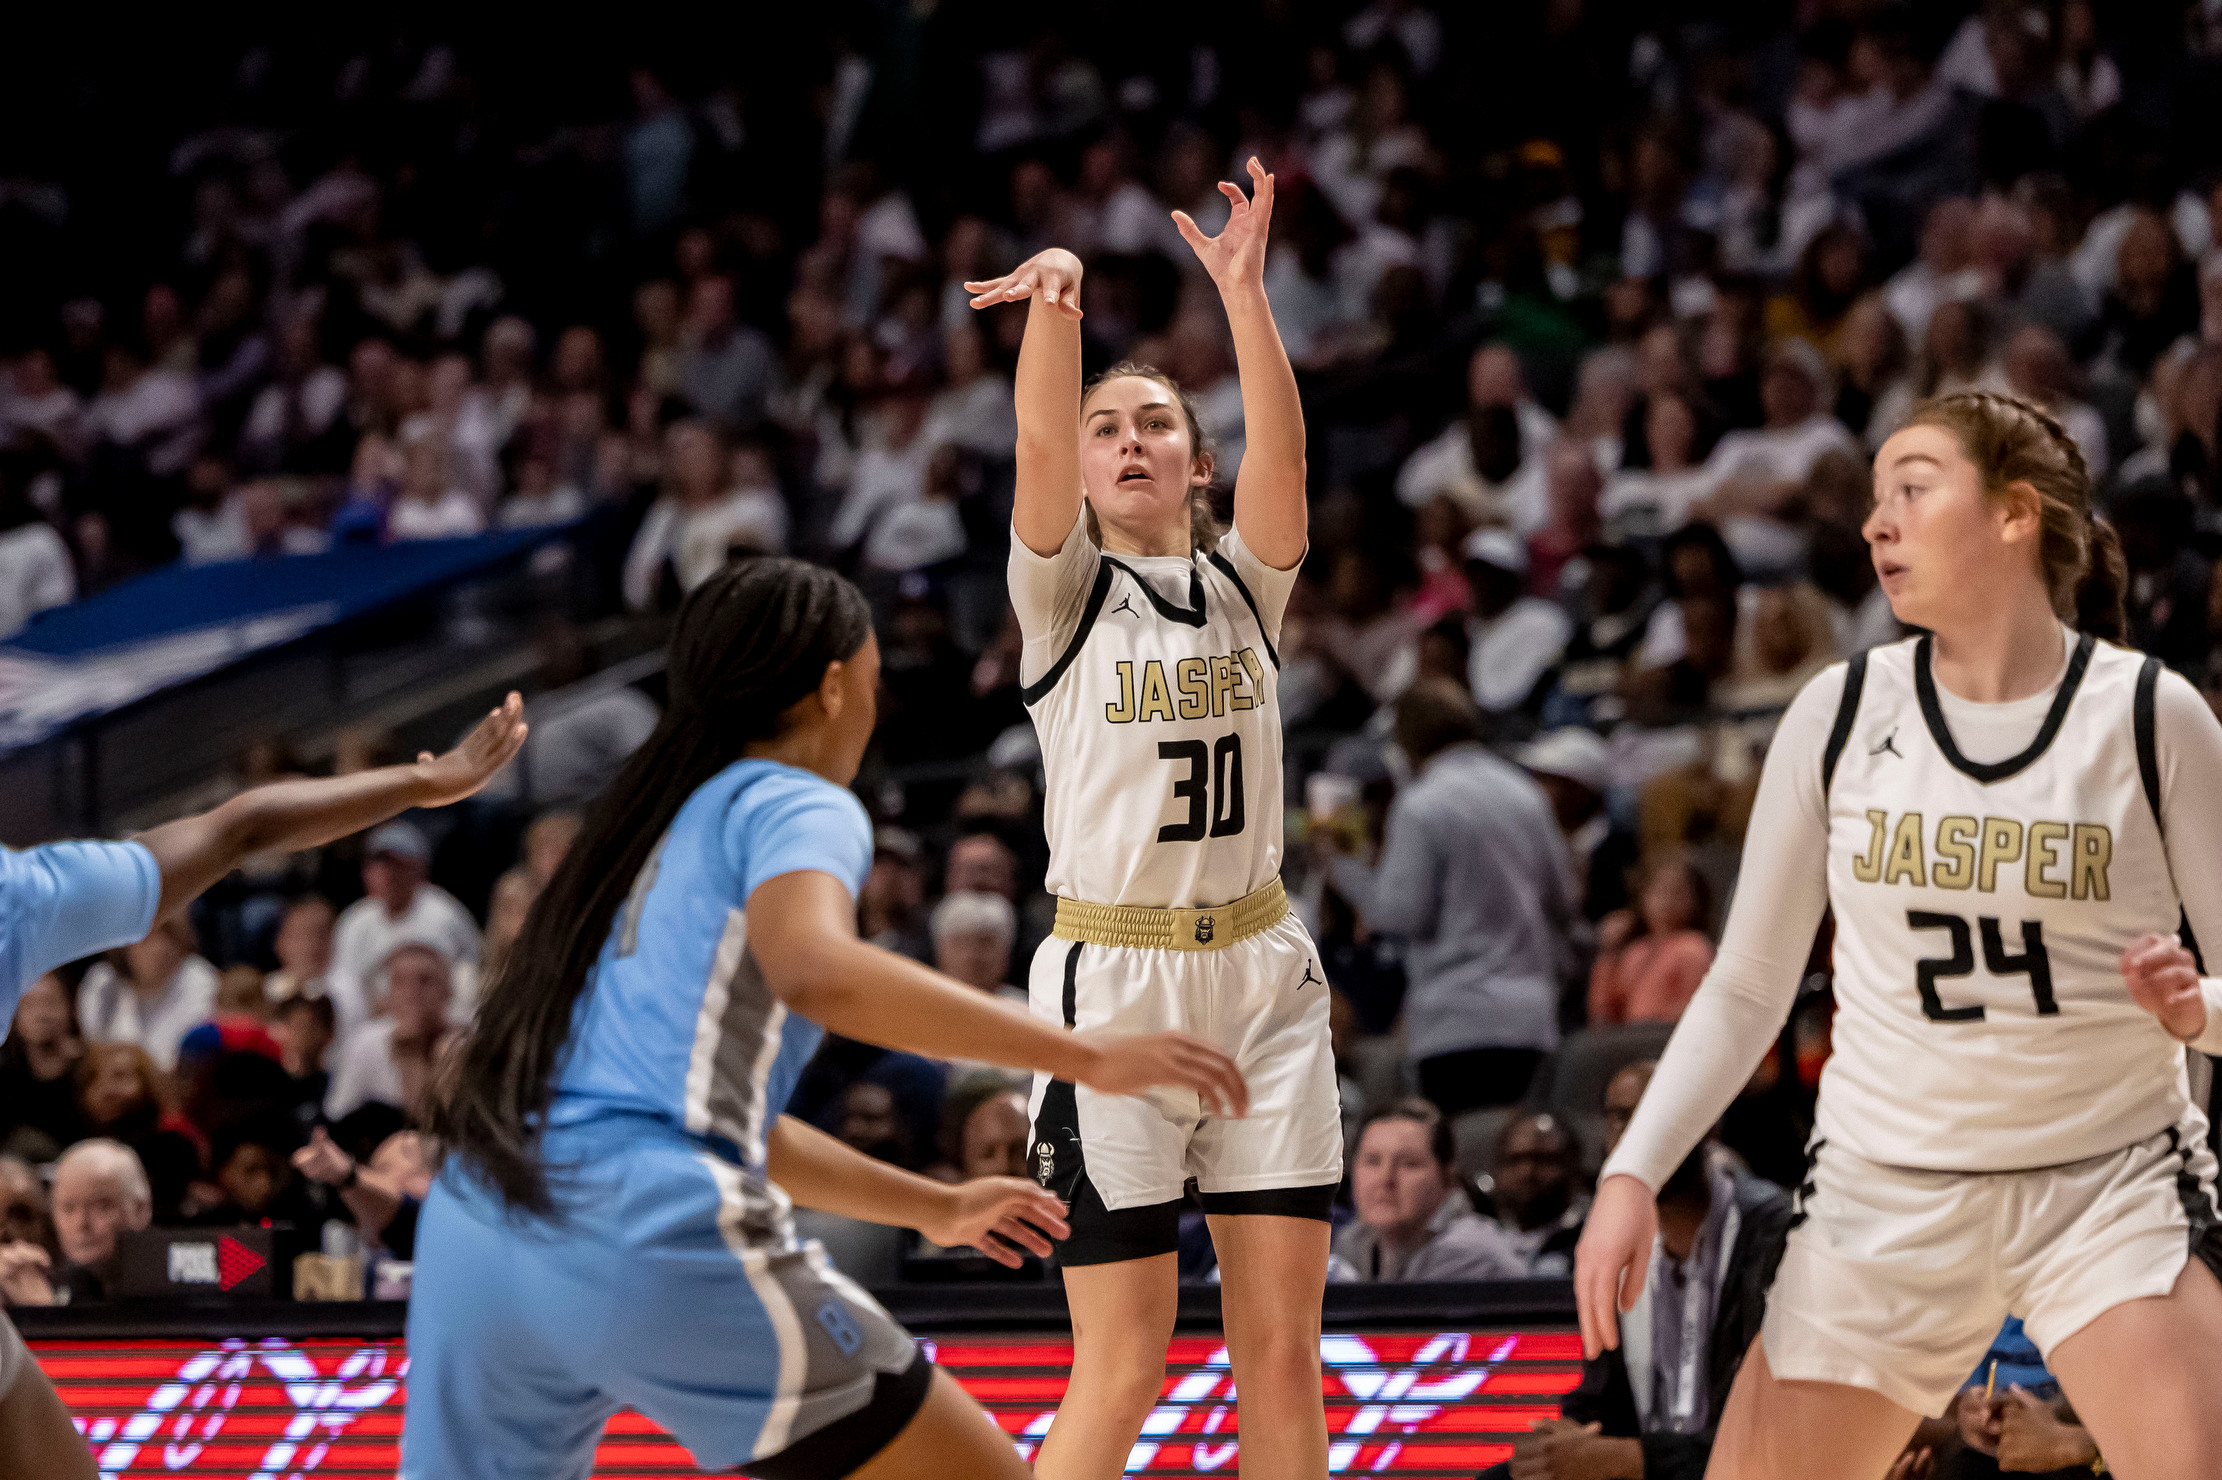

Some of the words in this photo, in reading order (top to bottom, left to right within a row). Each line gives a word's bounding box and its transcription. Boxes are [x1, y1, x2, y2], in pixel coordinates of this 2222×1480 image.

[1105, 647, 1266, 724] JASPER
[1156, 732, 1245, 844] 30
[1853, 809, 2113, 901] JASPER
[1907, 910, 2059, 1022] 24
